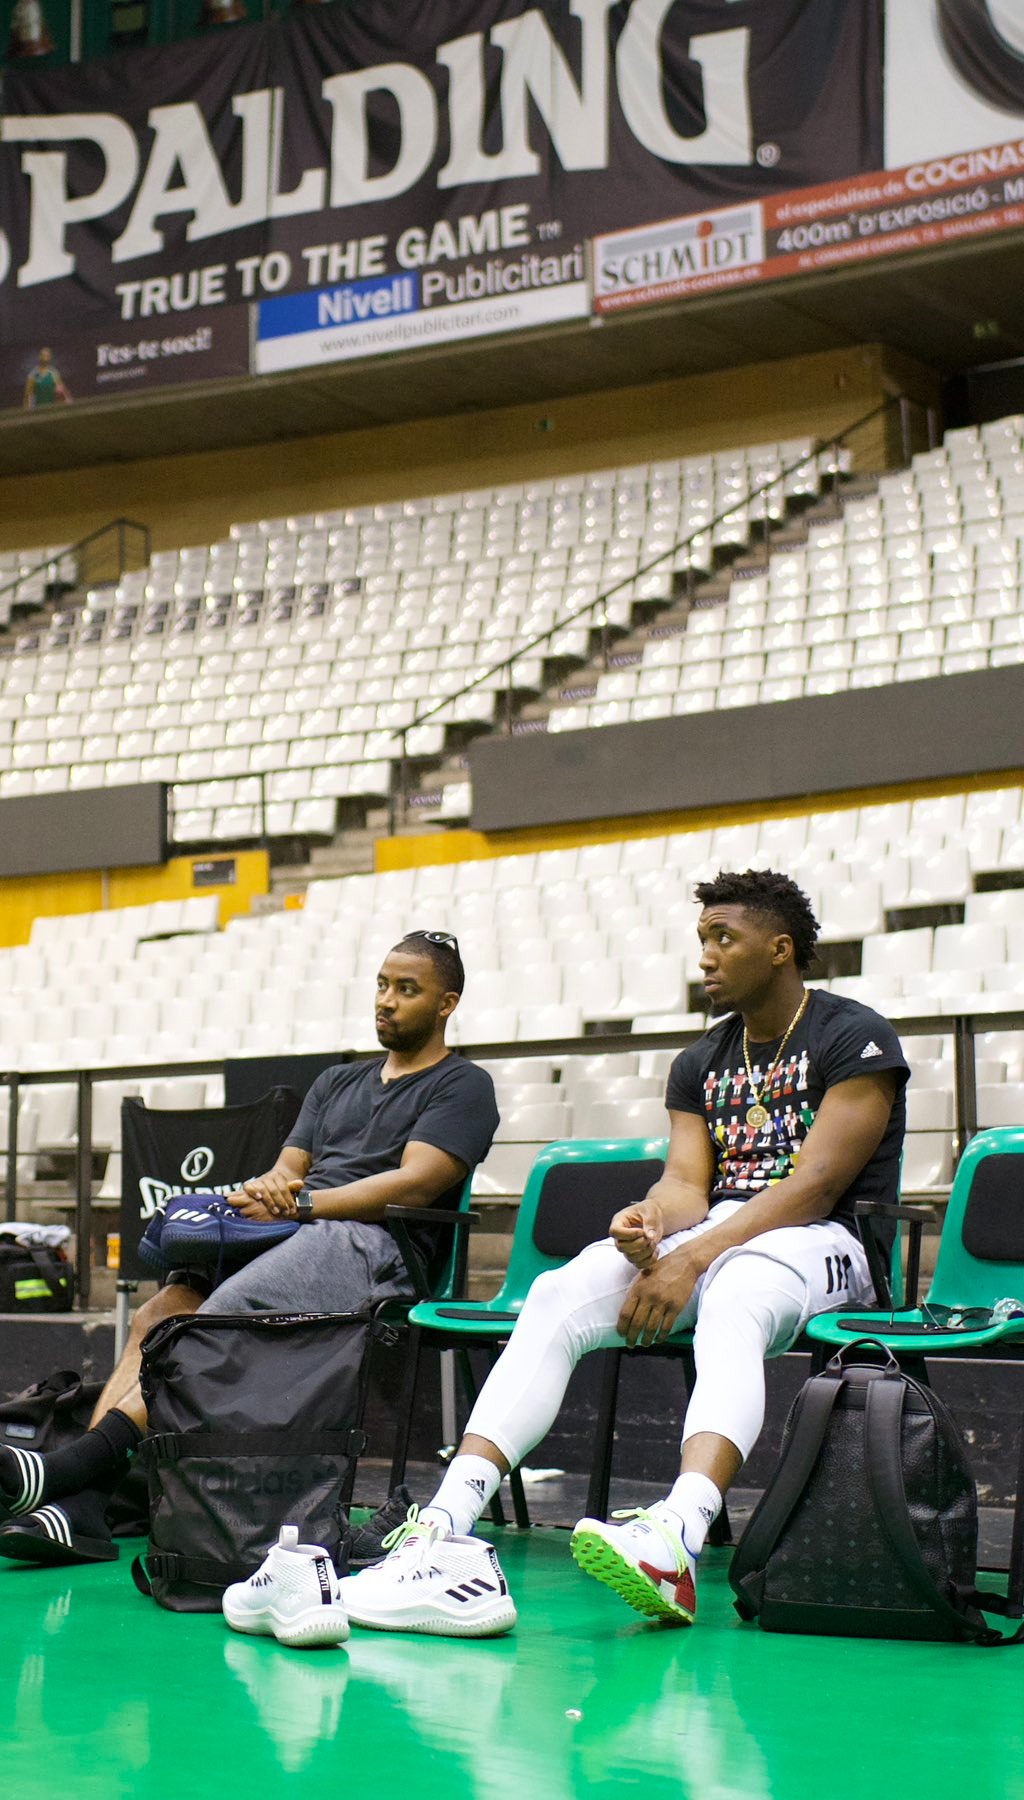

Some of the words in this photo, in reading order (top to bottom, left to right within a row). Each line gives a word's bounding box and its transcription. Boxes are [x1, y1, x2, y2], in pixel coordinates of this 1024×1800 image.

[115, 265, 227, 320] TRUE
[237, 252, 292, 297] TO
[301, 235, 387, 286] THE
[395, 203, 531, 269] GAME
[317, 278, 413, 326] Nivell
[422, 246, 584, 306] Publicitari
[319, 305, 521, 353] www.nivellpublicitari.com
